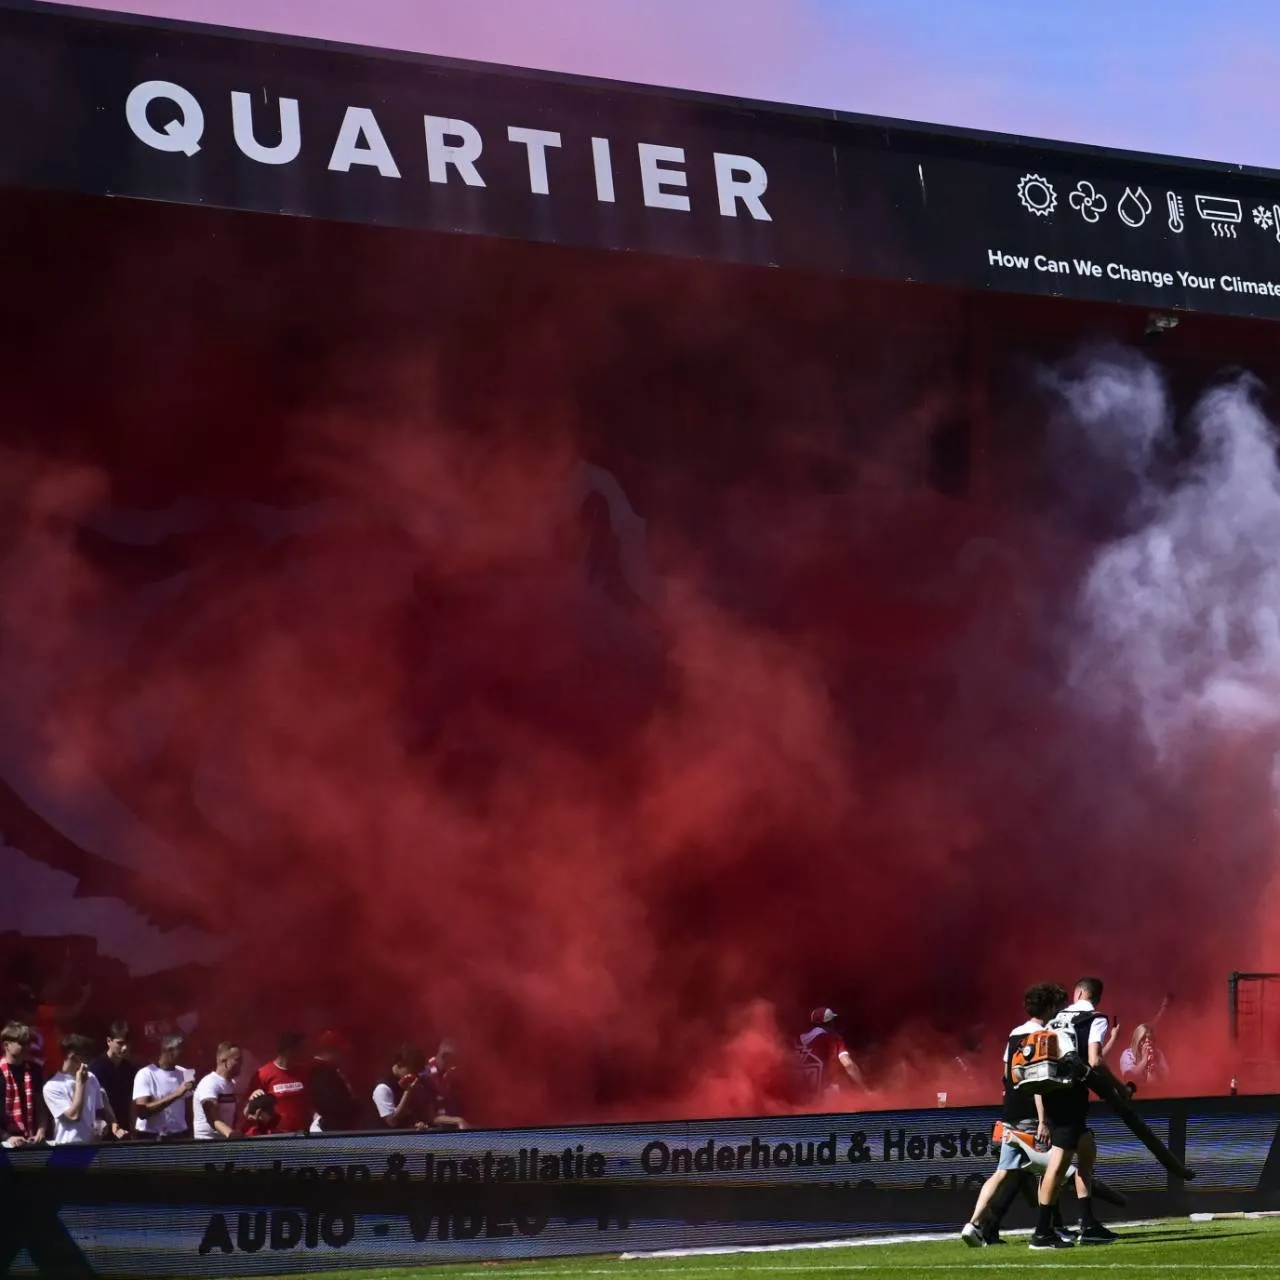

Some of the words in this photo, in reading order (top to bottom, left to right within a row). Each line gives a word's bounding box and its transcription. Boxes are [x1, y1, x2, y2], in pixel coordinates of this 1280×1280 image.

[125, 80, 773, 222] QUARTIER
[988, 249, 1029, 268] How
[1034, 254, 1070, 275] Can
[1073, 258, 1103, 278] We
[1107, 263, 1173, 287] Change
[1177, 270, 1215, 290] Your
[425, 1144, 607, 1183] Installatie
[640, 1131, 838, 1175] Onderhoud
[199, 1209, 356, 1254] AUDIO
